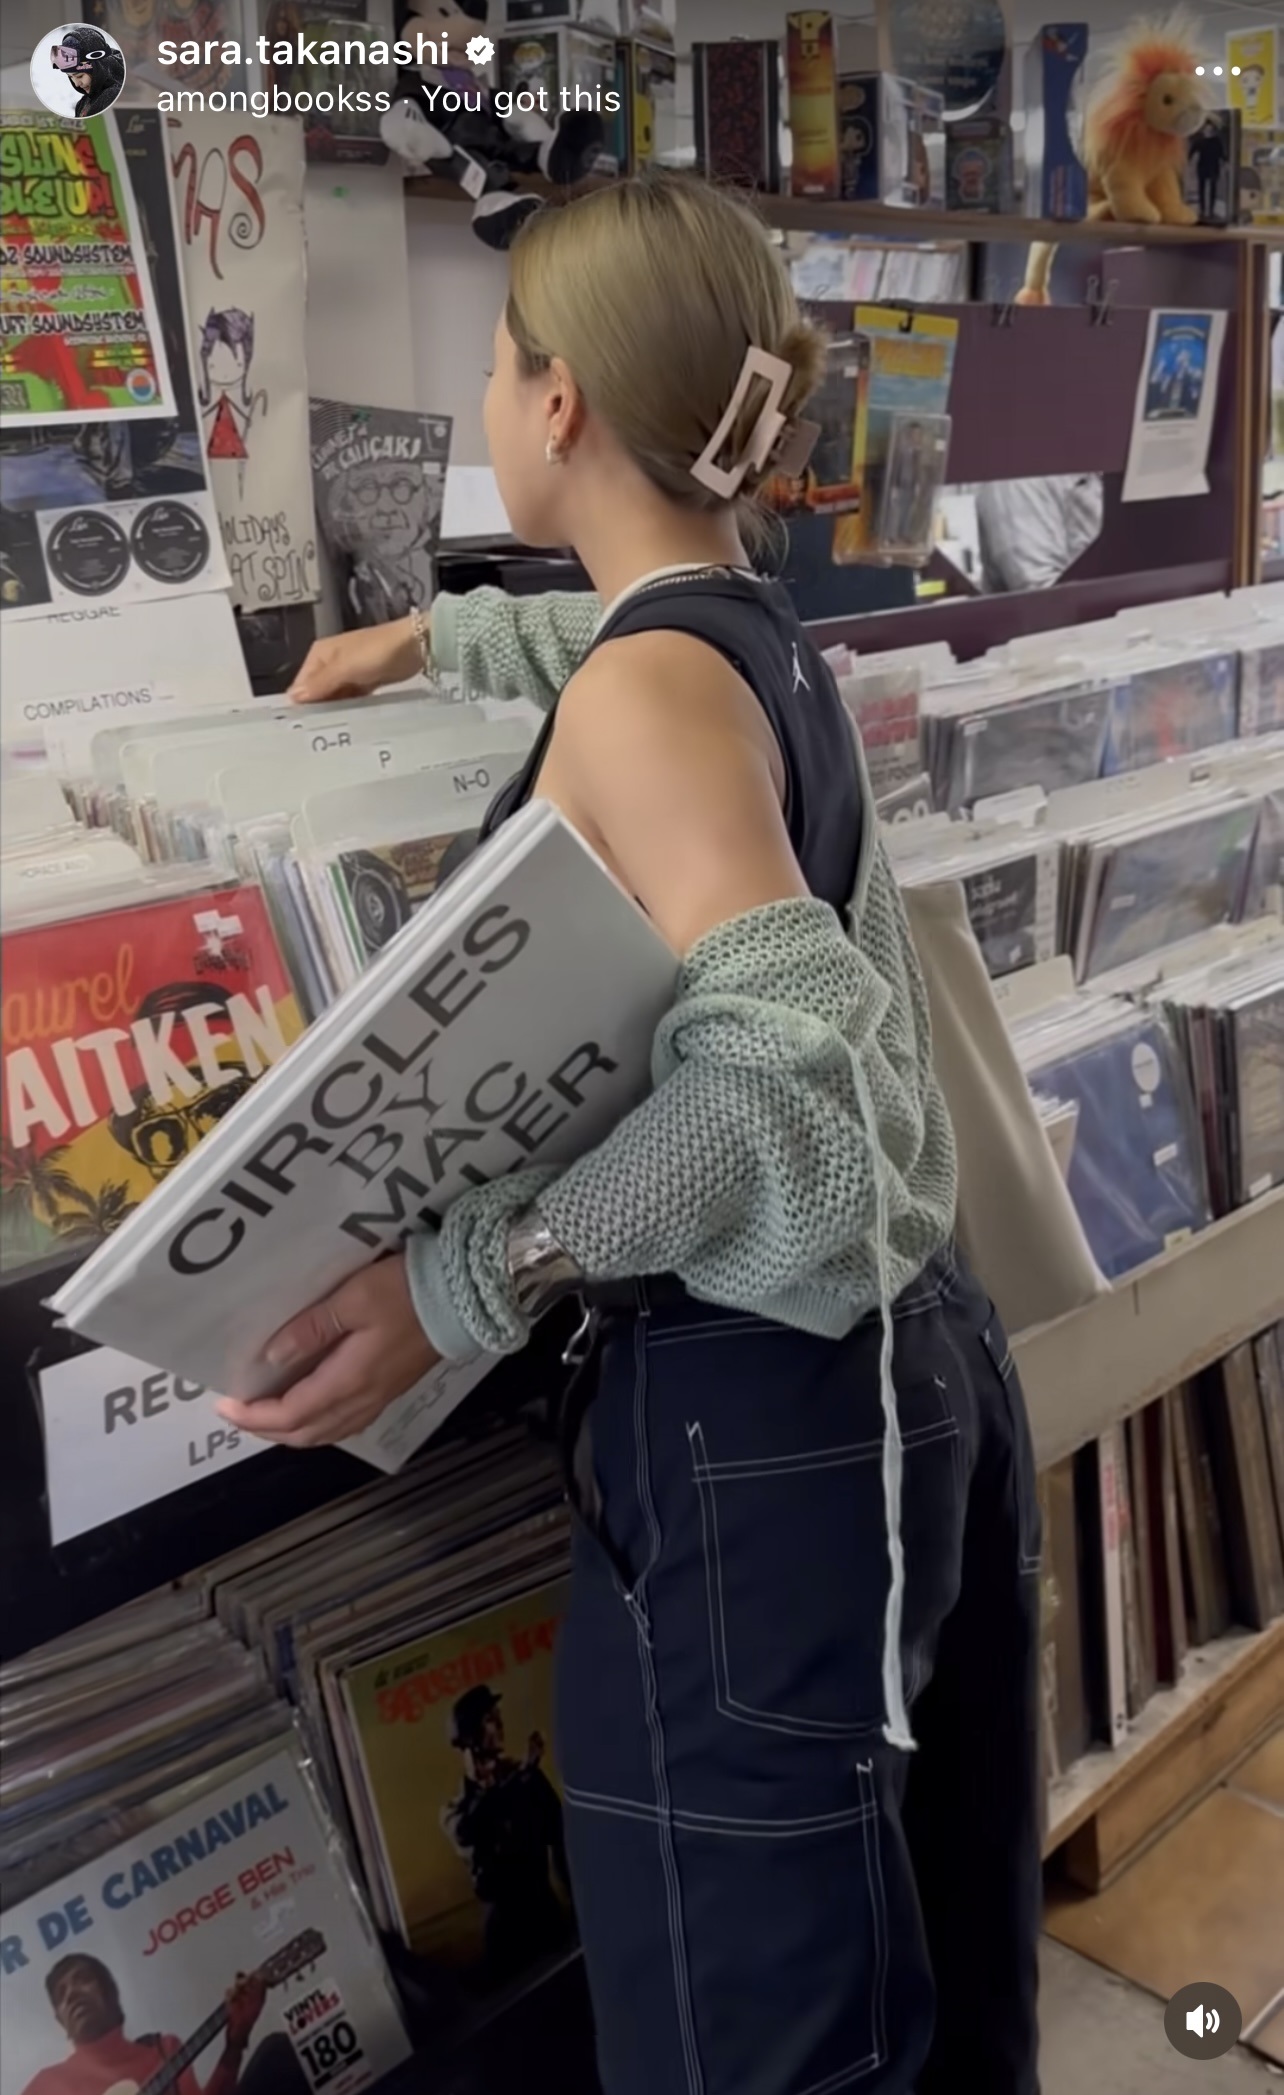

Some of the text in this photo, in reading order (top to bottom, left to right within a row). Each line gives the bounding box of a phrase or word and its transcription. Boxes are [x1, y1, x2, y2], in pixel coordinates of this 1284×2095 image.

[24, 243, 134, 265] SOUNDSYSTEM
[32, 311, 147, 334] SOUNDSYSTEM
[23, 688, 152, 721] COMPILATIONS
[6, 984, 290, 1149] AITKEN
[168, 904, 532, 1276] CIRCLES
[328, 1057, 448, 1190] BY
[339, 1060, 528, 1249] MAC
[188, 1429, 241, 1467] LPs
[37, 1894, 94, 1951] DE
[102, 1783, 290, 1910] CARNAVAL
[143, 1845, 296, 1957] JORGE BEN
[300, 2020, 358, 2077] 180
